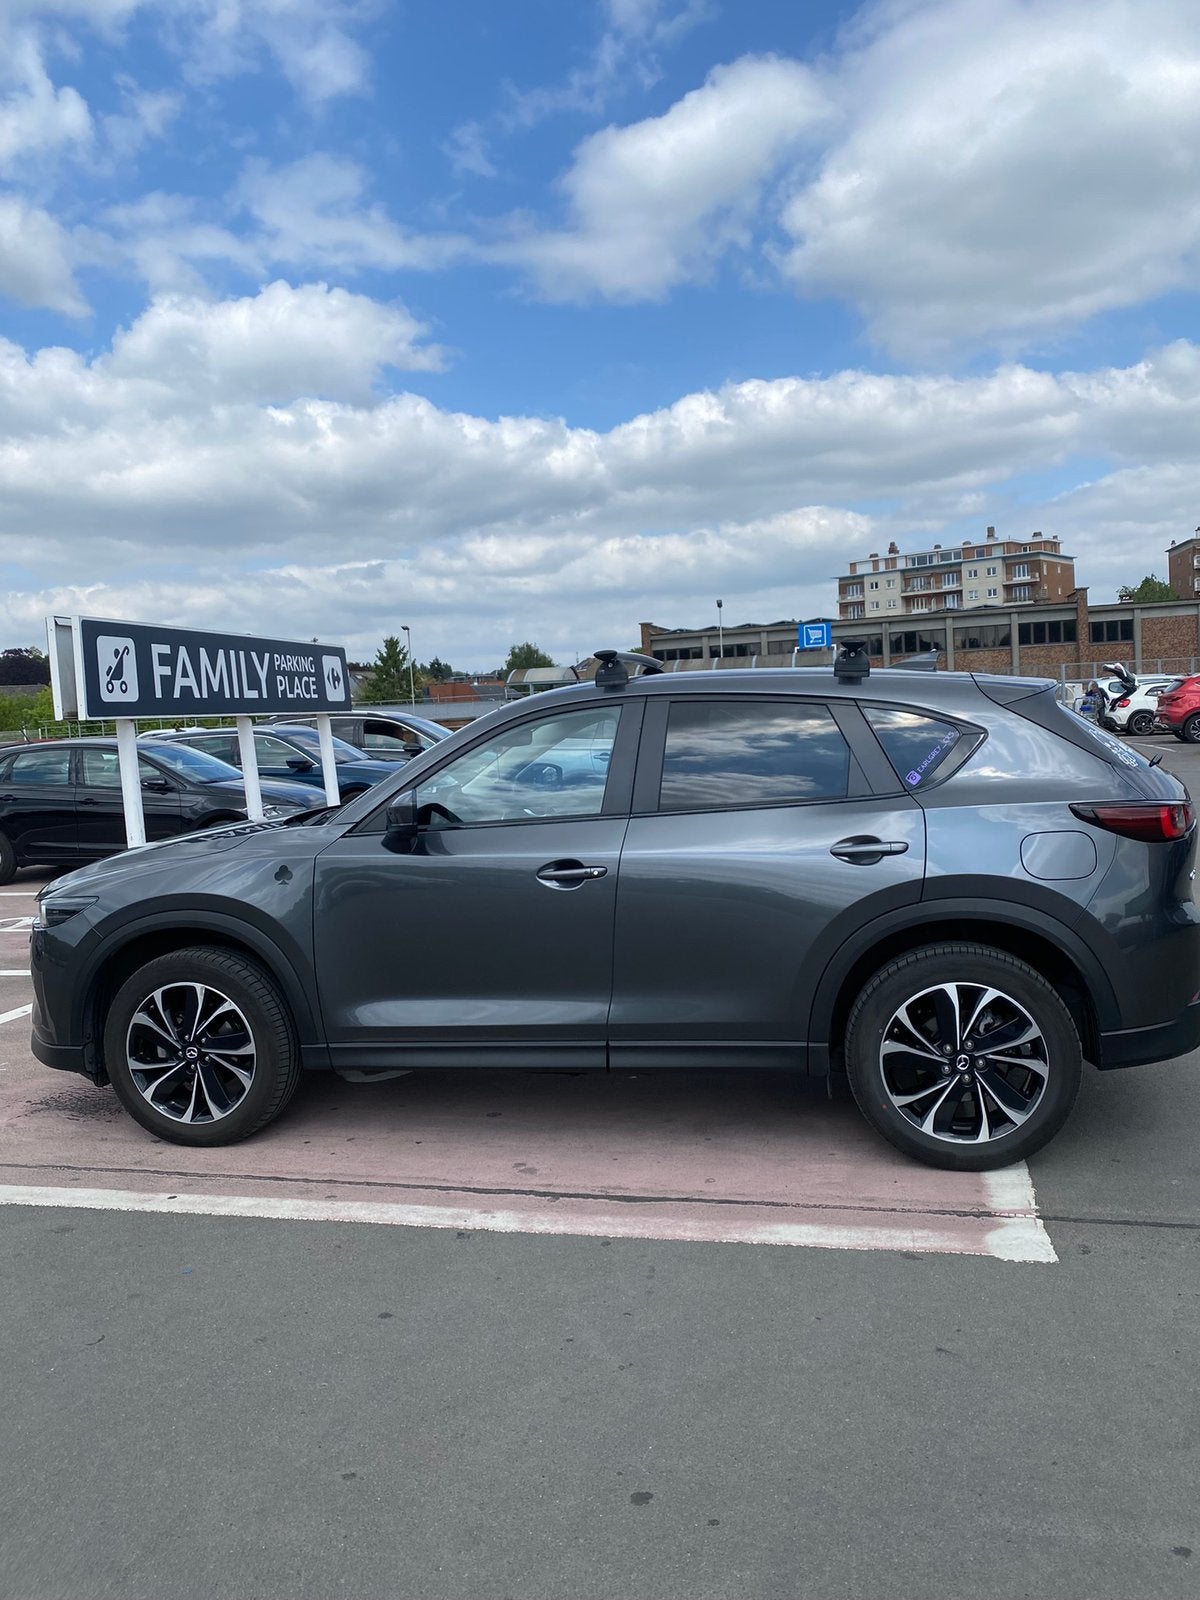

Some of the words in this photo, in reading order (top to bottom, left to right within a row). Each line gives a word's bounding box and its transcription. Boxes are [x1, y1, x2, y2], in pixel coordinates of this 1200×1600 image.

[151, 643, 270, 699] FAMILY
[273, 653, 315, 673] PARKING
[276, 675, 318, 699] PLACE
